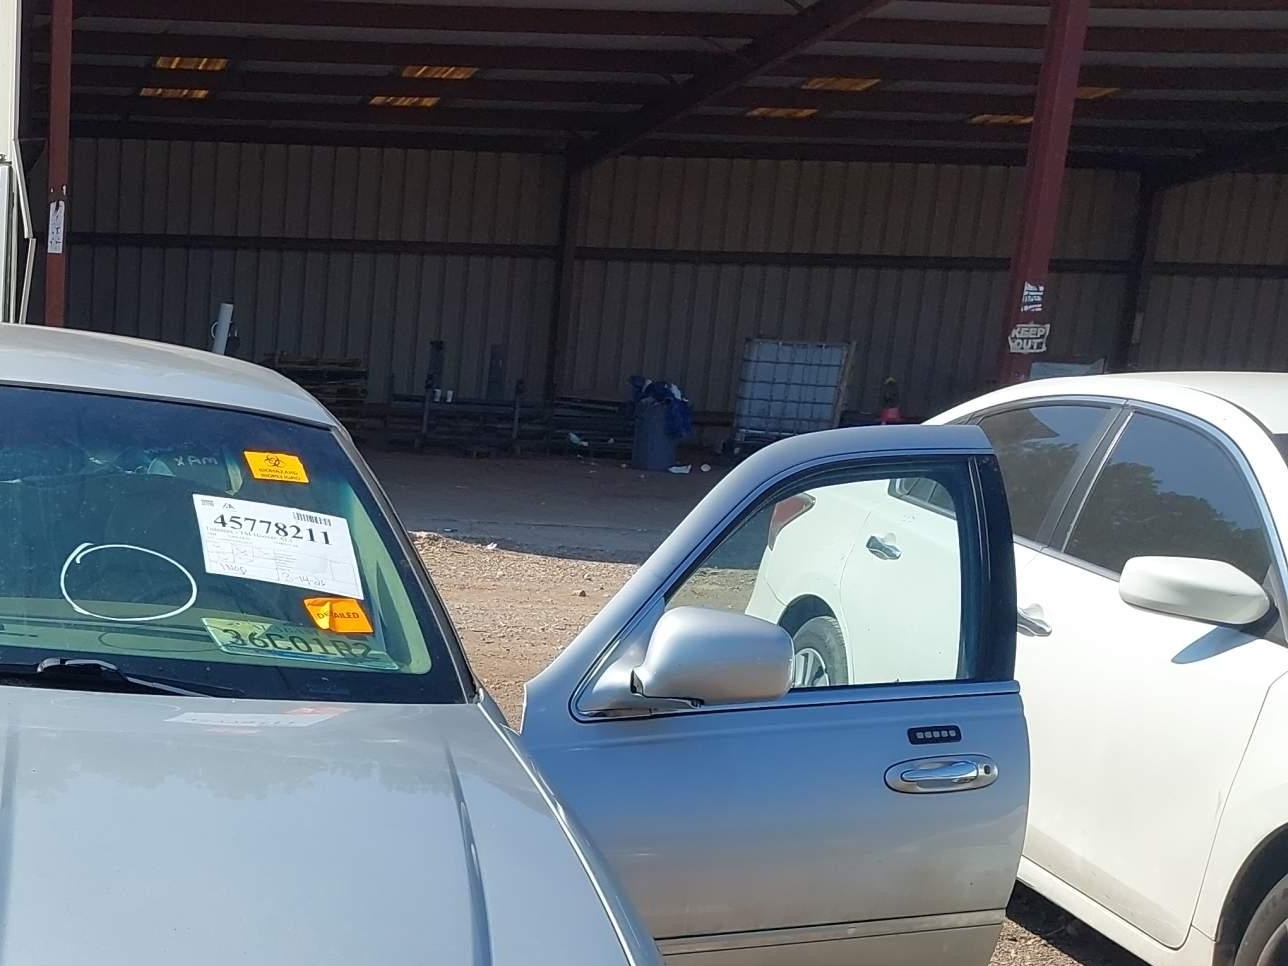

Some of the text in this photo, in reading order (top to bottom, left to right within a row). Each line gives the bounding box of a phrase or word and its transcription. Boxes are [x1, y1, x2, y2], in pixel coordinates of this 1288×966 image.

[1012, 327, 1045, 338] KEEP
[1014, 339, 1043, 350] OUT
[214, 513, 333, 546] 45778211
